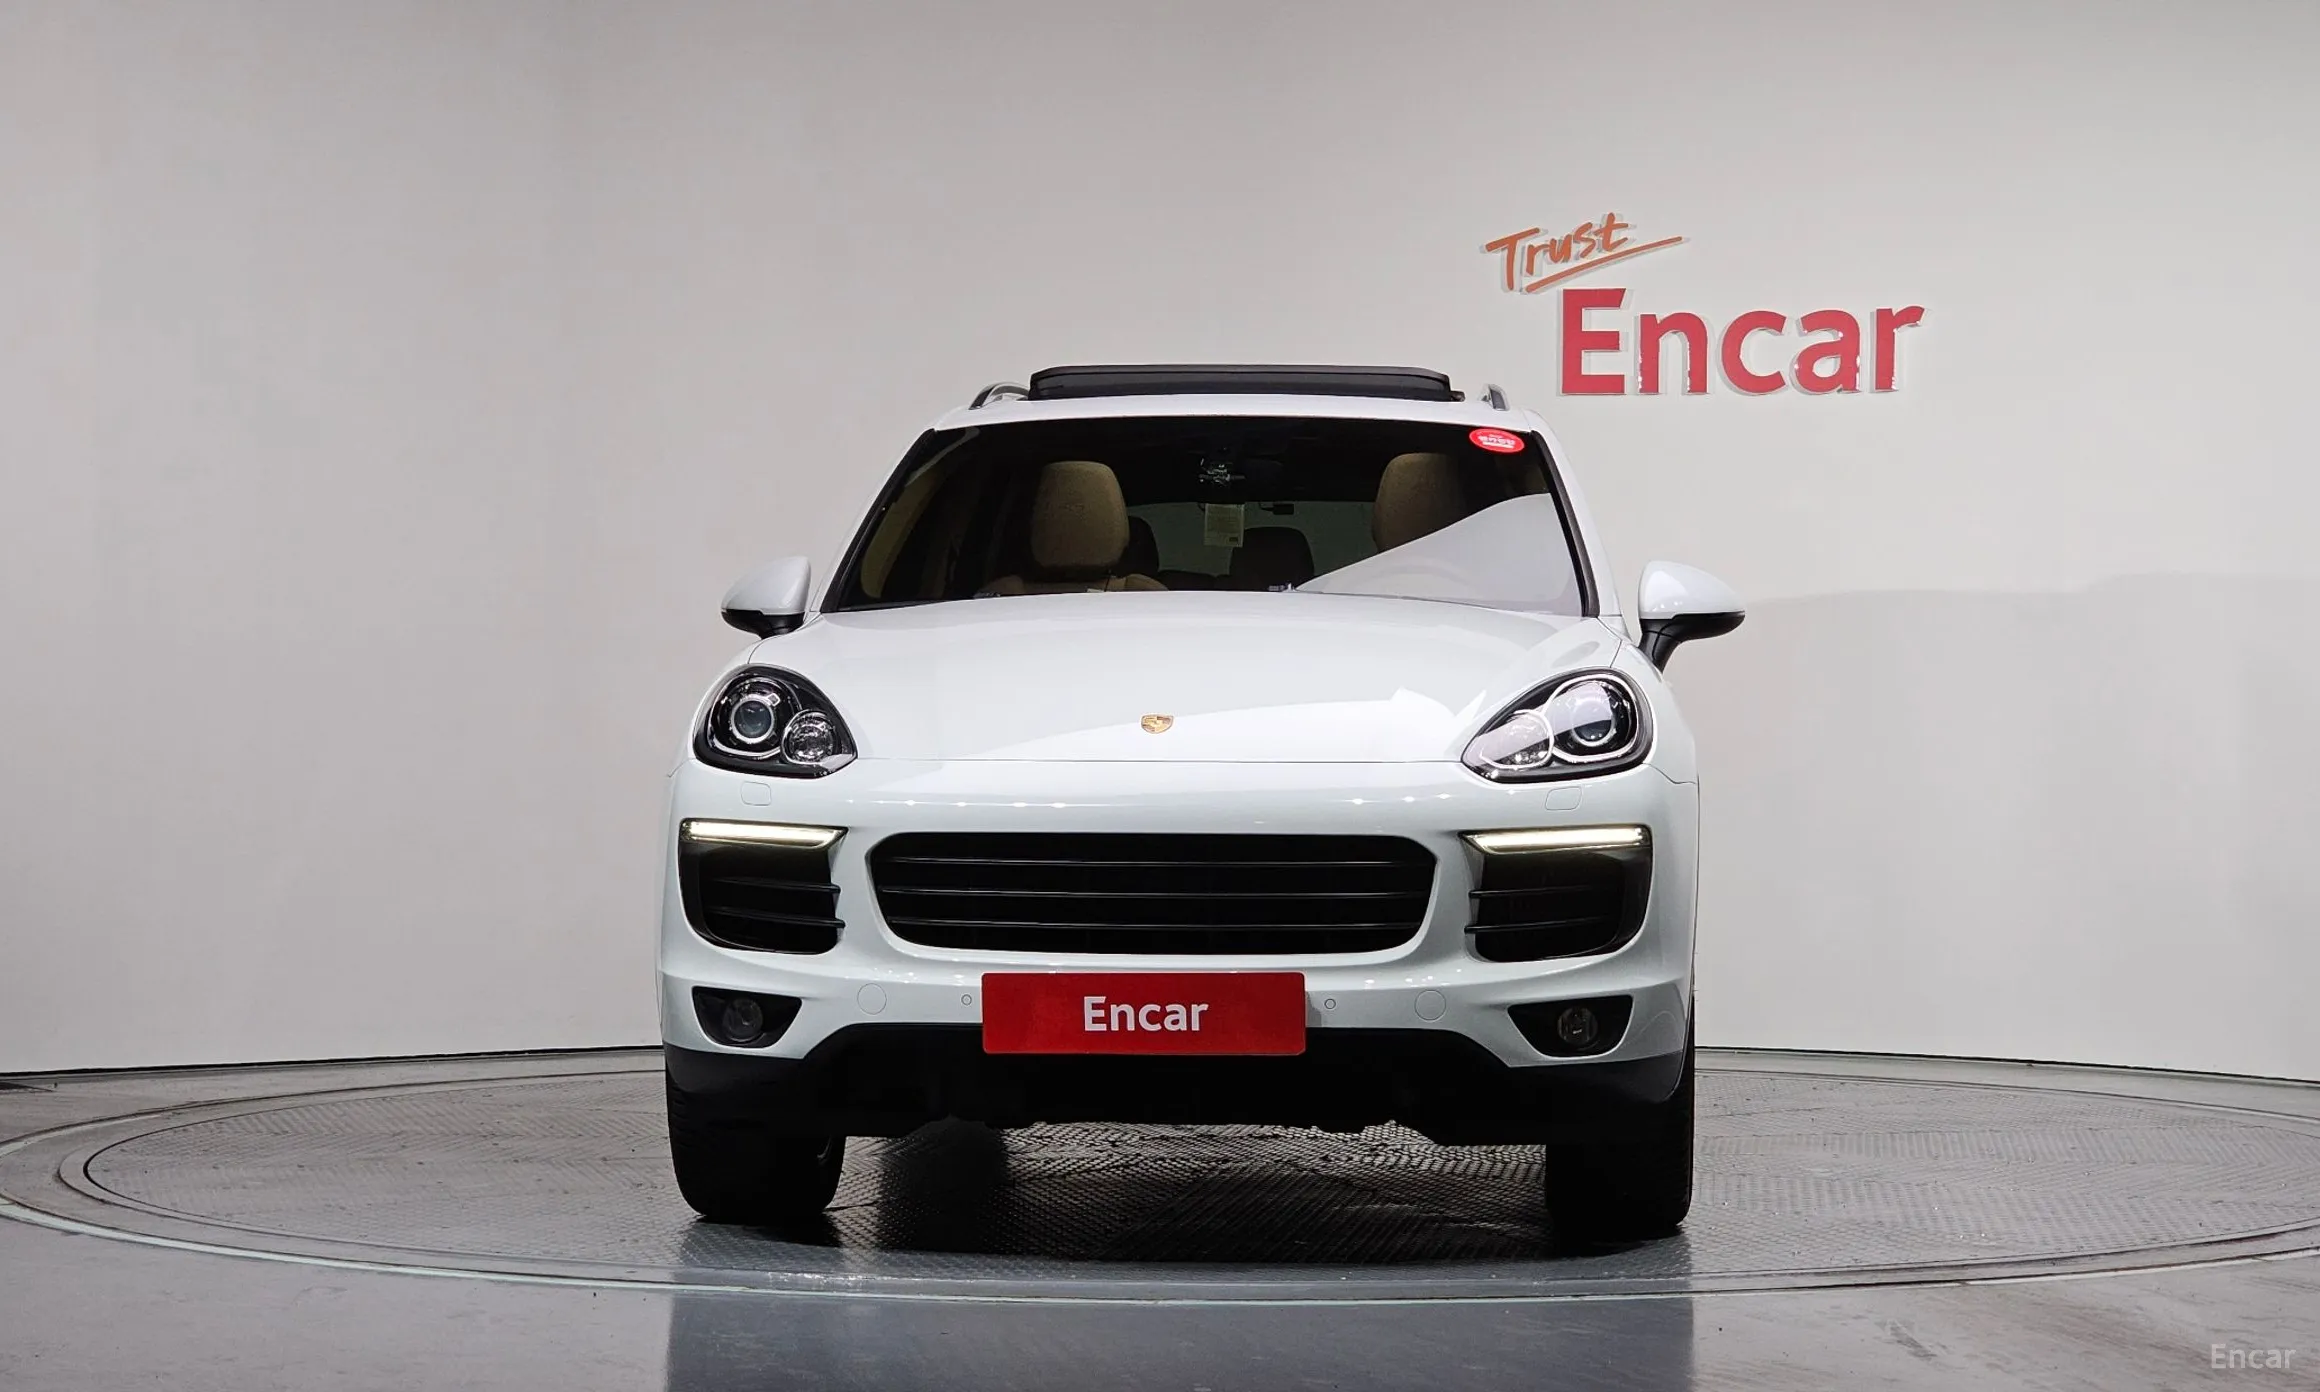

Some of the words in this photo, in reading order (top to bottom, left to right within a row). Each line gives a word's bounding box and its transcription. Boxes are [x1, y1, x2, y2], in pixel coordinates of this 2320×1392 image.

[1485, 212, 1629, 291] Trust
[1562, 288, 1925, 394] Encar
[1084, 996, 1209, 1031] Encar
